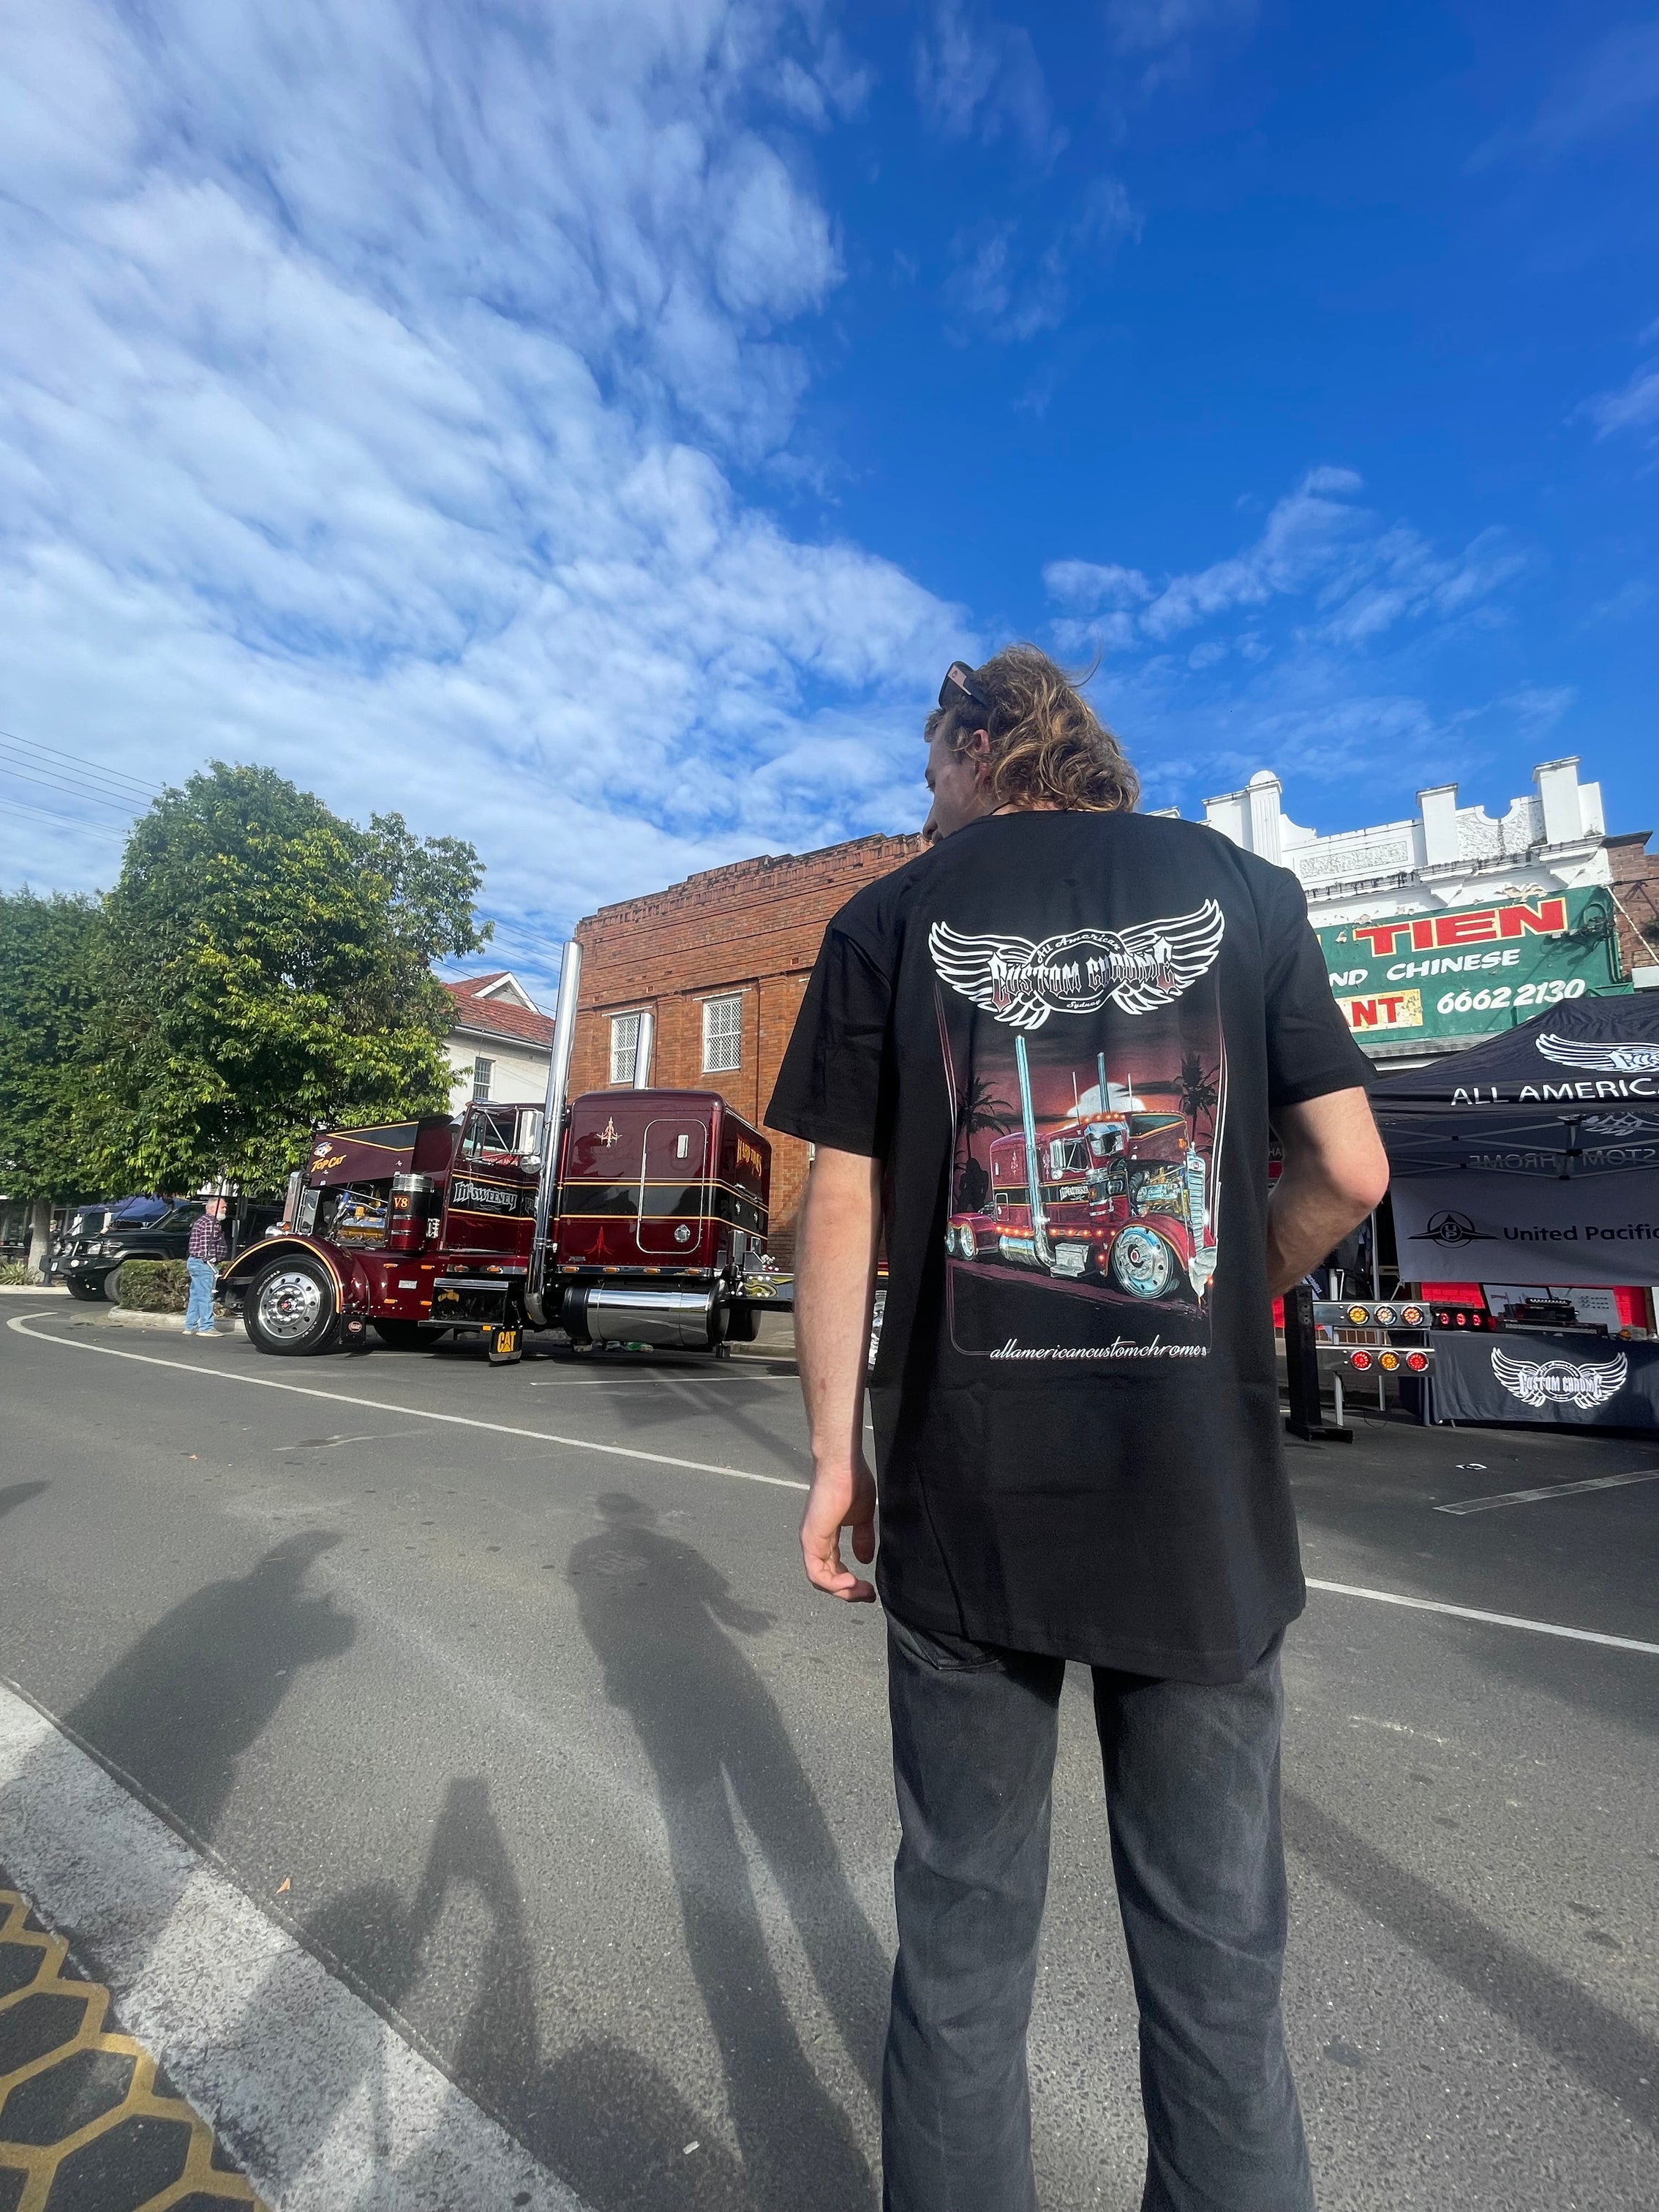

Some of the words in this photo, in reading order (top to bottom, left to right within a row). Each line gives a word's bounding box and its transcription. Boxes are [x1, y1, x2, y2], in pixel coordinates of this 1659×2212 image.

[1353, 898, 1568, 958] TIEN
[1037, 944, 1053, 963] All
[1056, 934, 1121, 951] American
[1328, 968, 1369, 988] ND
[1386, 949, 1521, 981] CHINESE
[1066, 999, 1102, 1009] Sydney
[1344, 996, 1404, 1028] NT
[1451, 1086, 1510, 1106] ALL
[1519, 1077, 1659, 1102] AMERIC
[394, 1196, 409, 1209] V8
[1503, 1225, 1577, 1241] United
[497, 1331, 516, 1353] CAT
